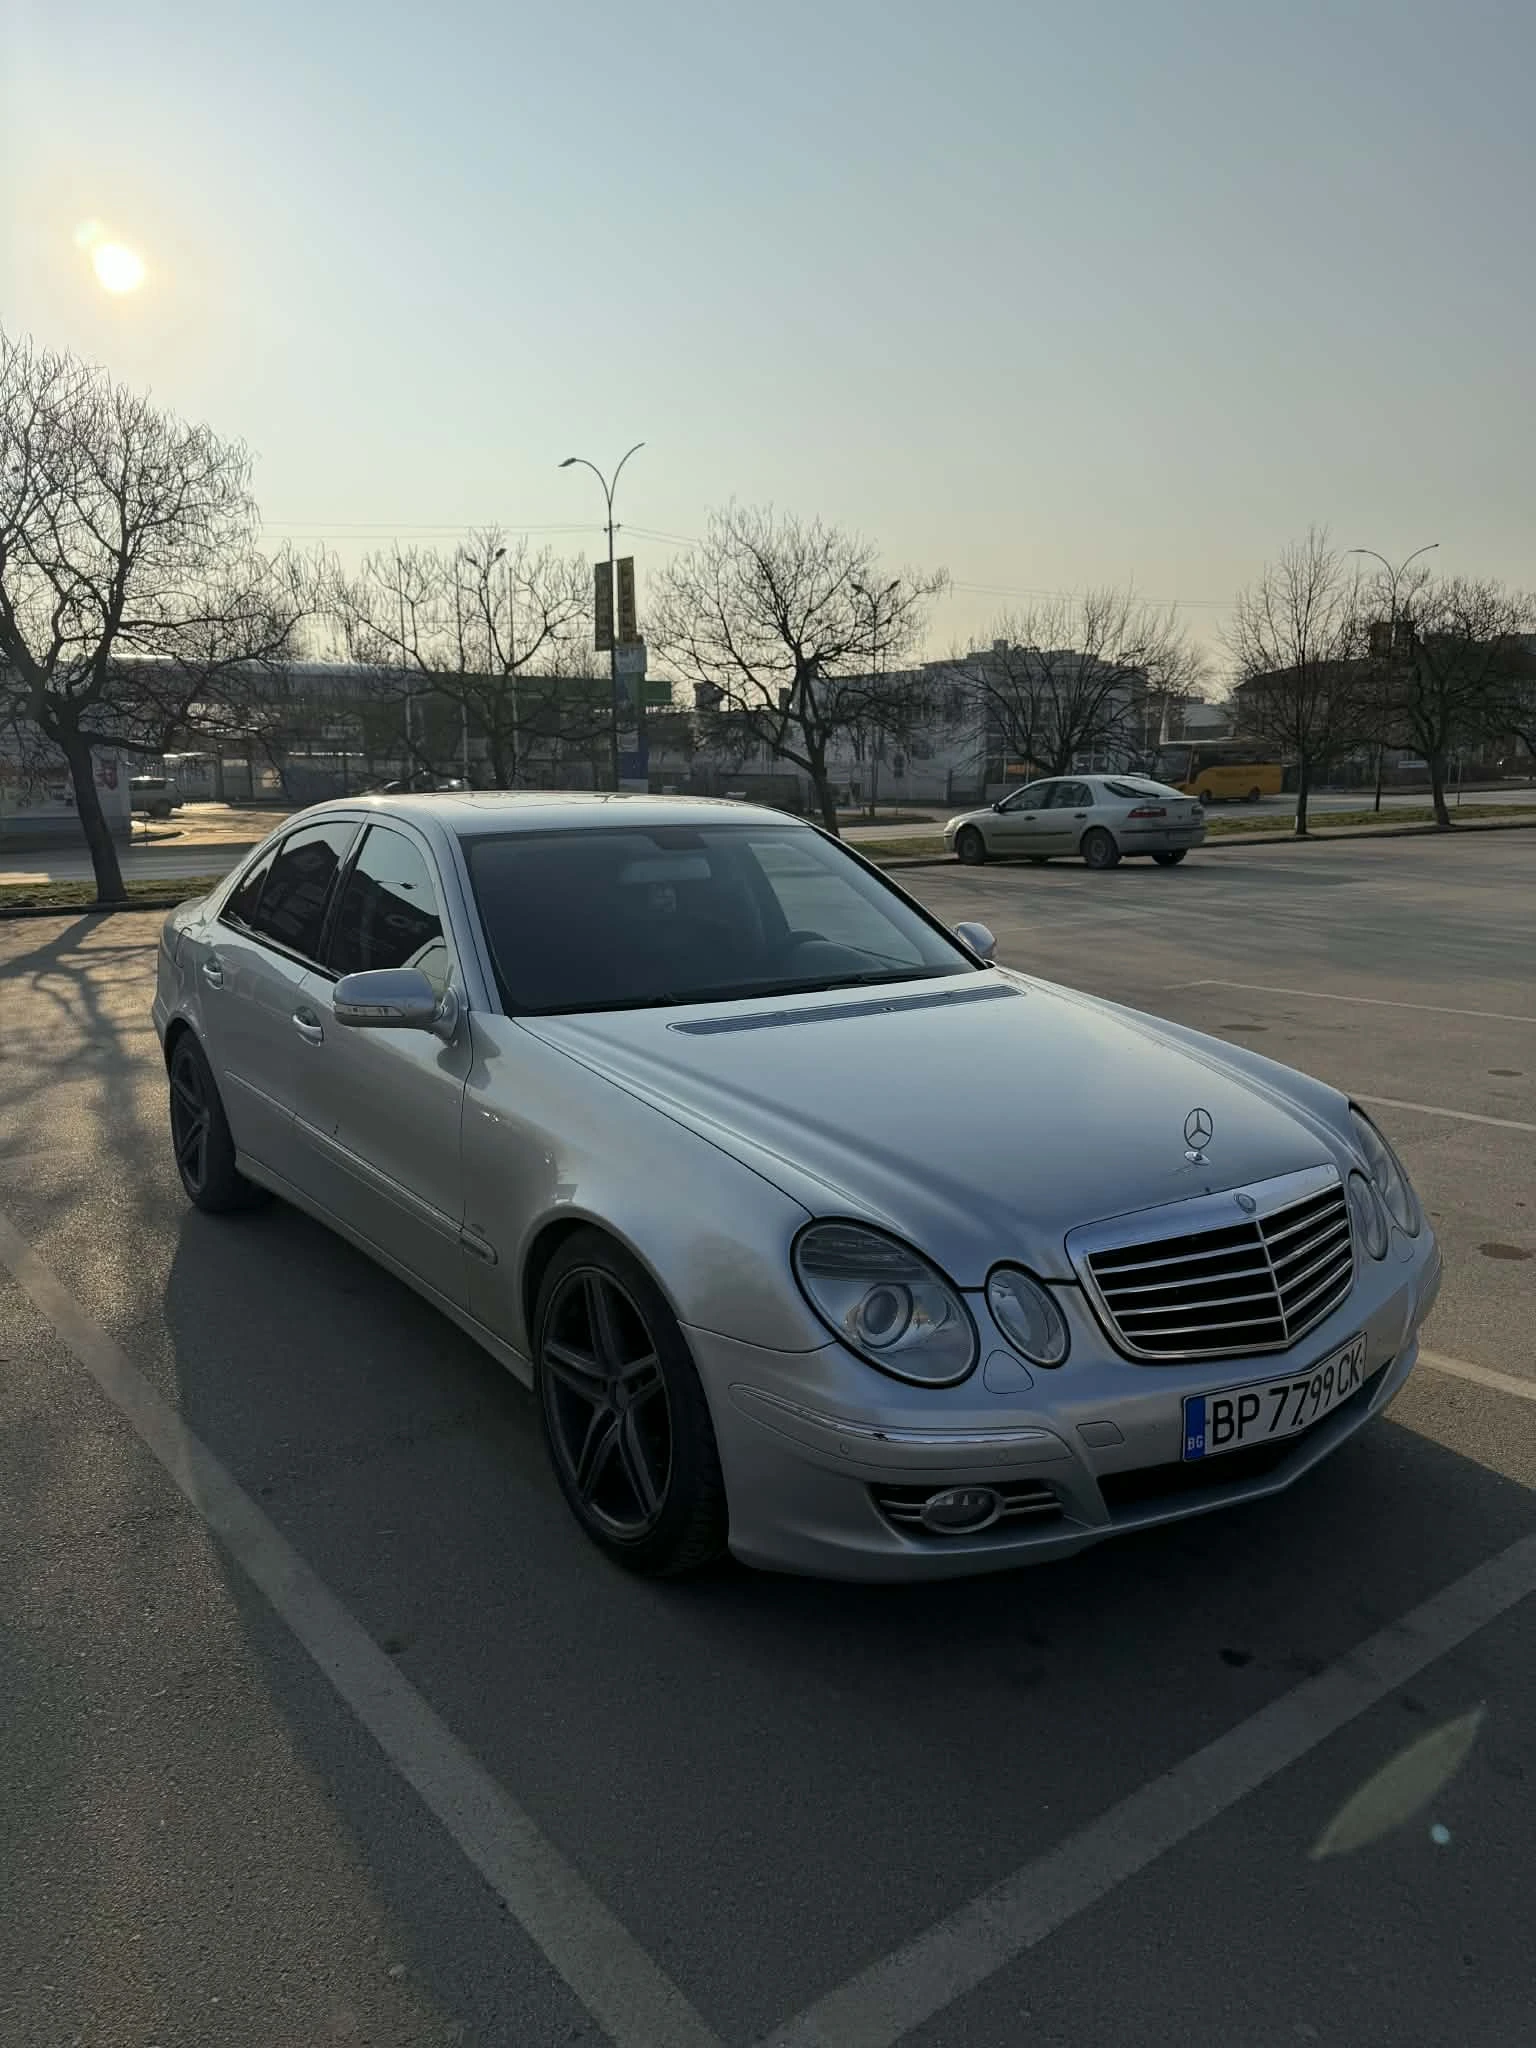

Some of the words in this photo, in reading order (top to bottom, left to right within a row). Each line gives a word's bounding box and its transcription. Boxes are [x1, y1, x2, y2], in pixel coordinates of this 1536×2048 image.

[1212, 1393, 1260, 1446] BP
[1268, 1364, 1335, 1433] 7799
[1336, 1343, 1363, 1396] CK
[1187, 1434, 1204, 1451] BG
